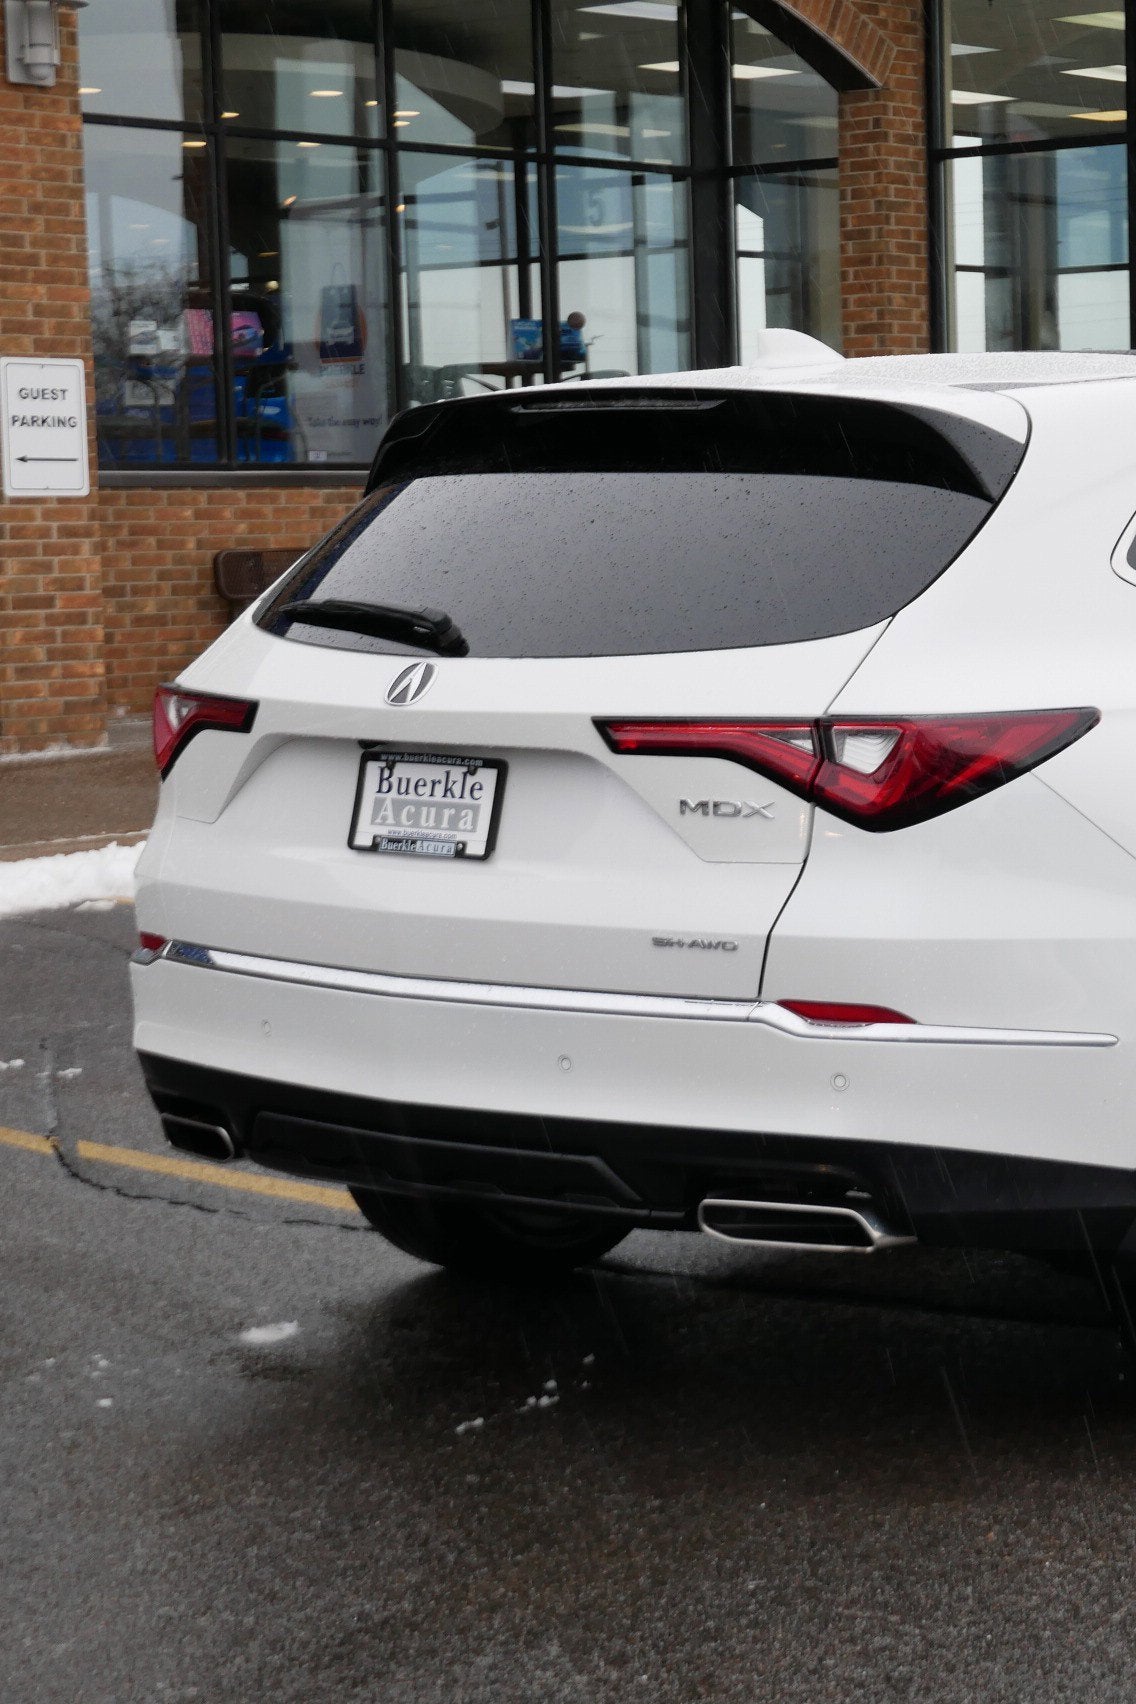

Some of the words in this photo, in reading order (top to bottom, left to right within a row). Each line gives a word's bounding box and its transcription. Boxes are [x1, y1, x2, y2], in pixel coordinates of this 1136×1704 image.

[18, 386, 69, 401] GUEST
[11, 414, 78, 428] PARKING
[381, 753, 484, 767] www.buerkleacura.com
[376, 765, 484, 801] Buerkle
[374, 797, 475, 831] Acura
[679, 799, 776, 819] MDX
[381, 838, 417, 852] Buerkle
